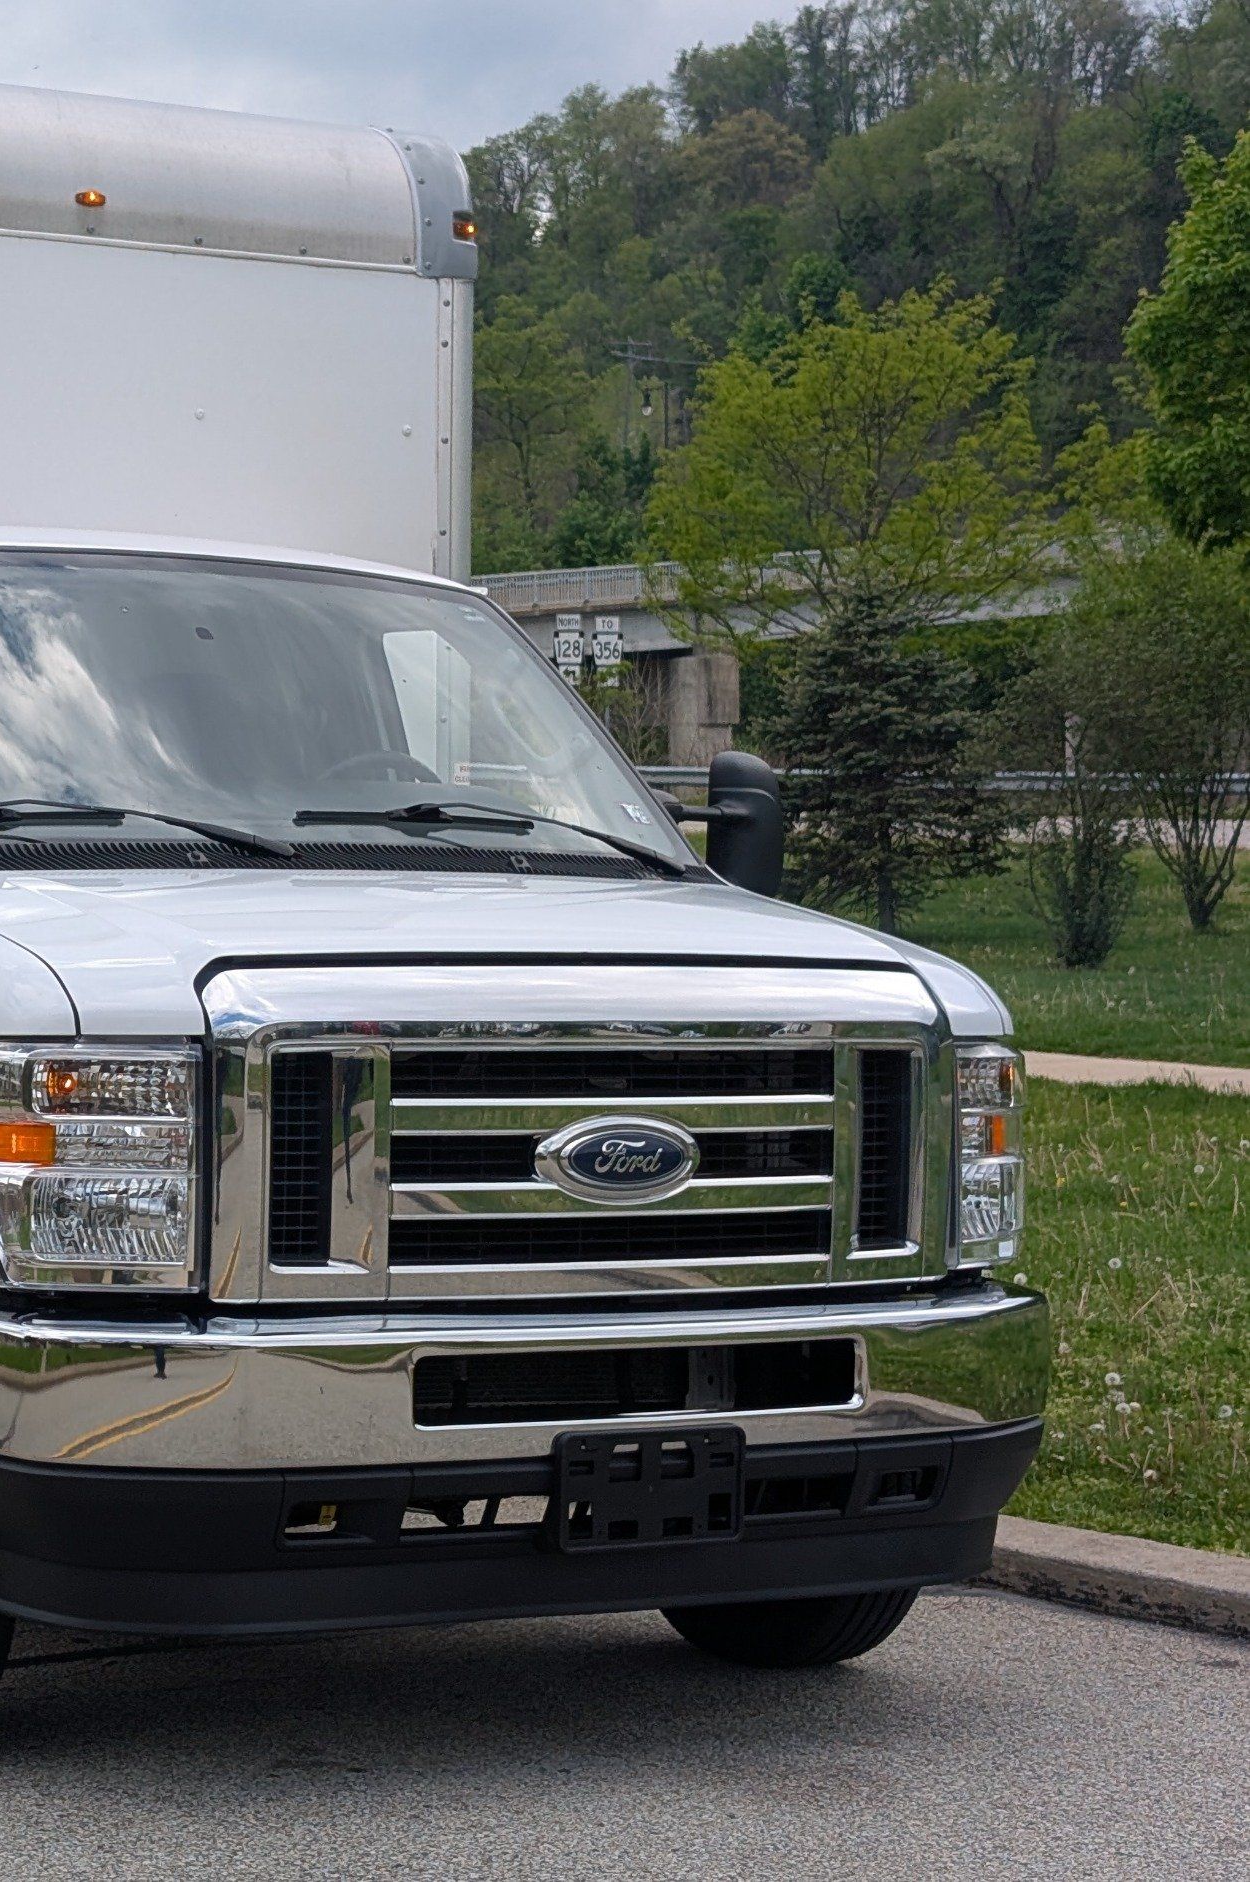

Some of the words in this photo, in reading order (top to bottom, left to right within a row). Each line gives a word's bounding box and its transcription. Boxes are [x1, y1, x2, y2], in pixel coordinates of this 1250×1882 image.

[558, 617, 579, 627] NORTH
[601, 620, 613, 629] TO
[556, 640, 581, 658] 128
[595, 641, 621, 660] 356
[594, 1139, 664, 1174] Ford
